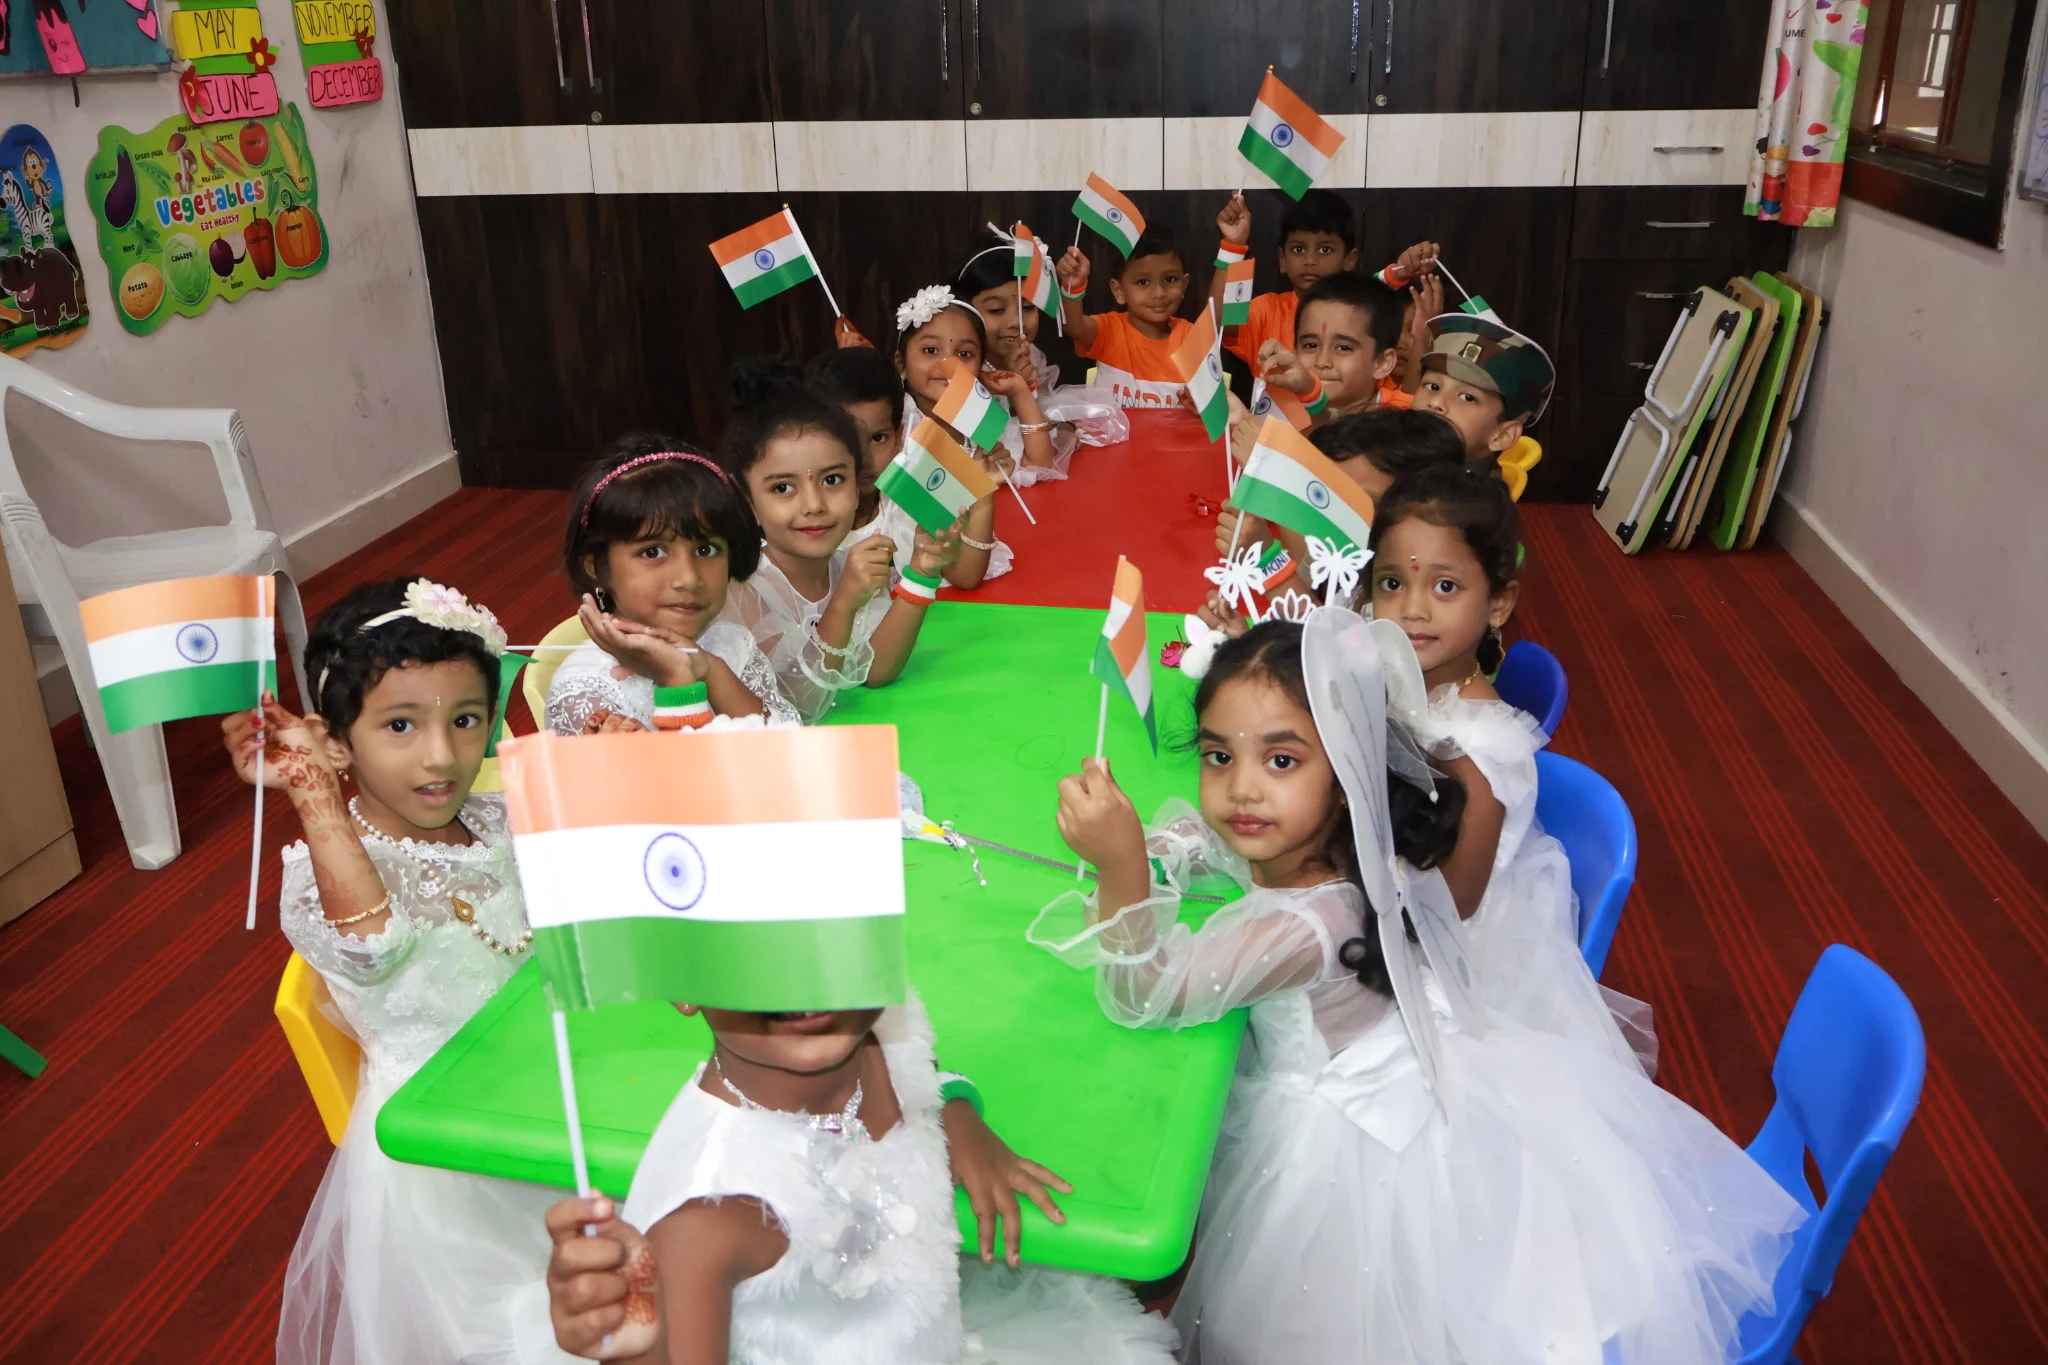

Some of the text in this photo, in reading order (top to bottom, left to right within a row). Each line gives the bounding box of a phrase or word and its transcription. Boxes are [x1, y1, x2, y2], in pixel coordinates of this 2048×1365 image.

[194, 9, 236, 52] MAY
[295, 2, 374, 39] NOVEMBER
[201, 74, 265, 117] JUNE
[310, 64, 380, 103] DECEMBER
[155, 179, 265, 226] Vegetables
[200, 213, 240, 232] Eat Healthy
[171, 251, 193, 263] Cabbage
[127, 281, 148, 293] Potato
[1113, 384, 1186, 408] INDI
